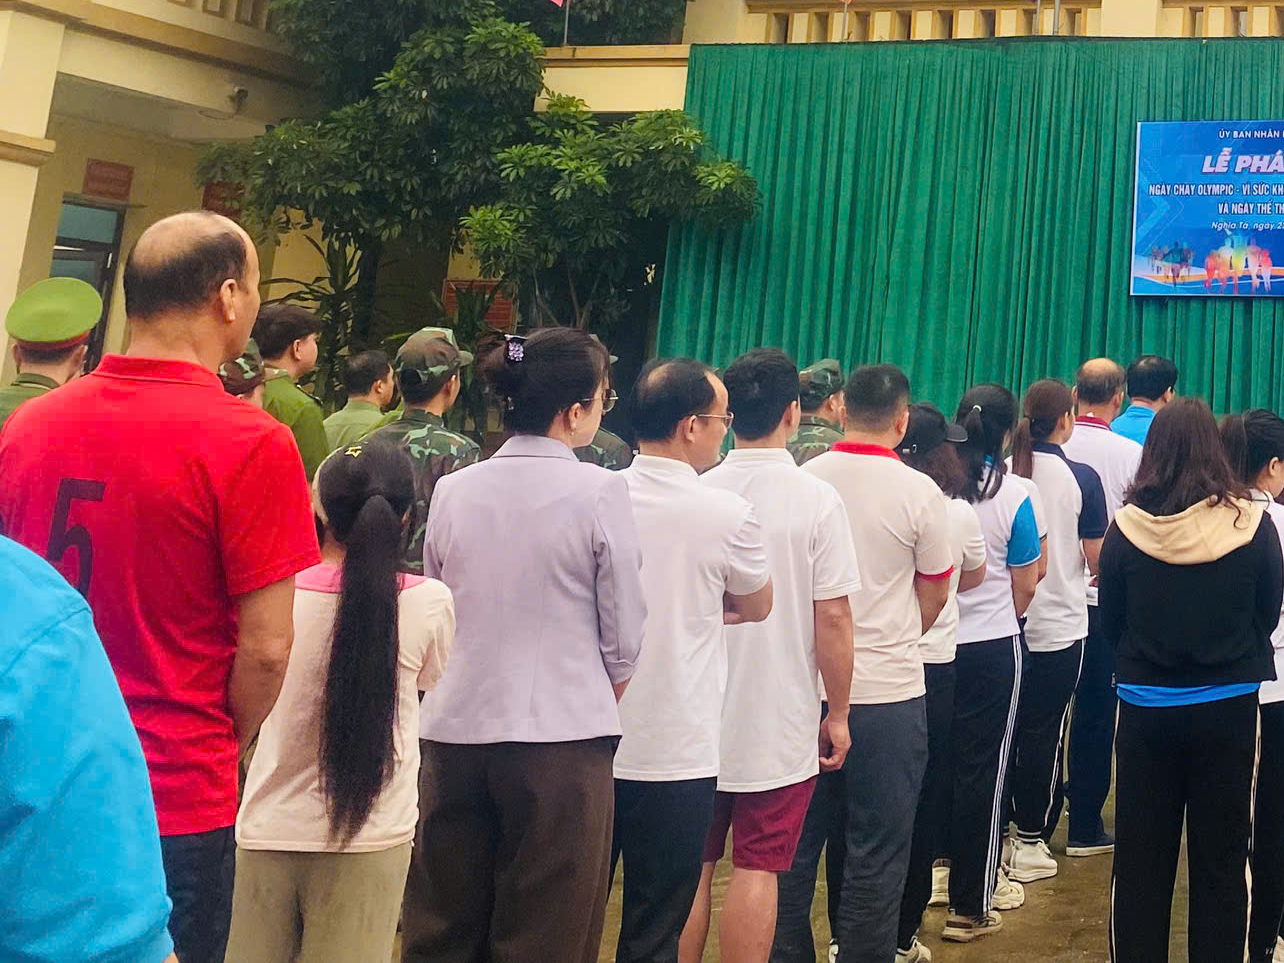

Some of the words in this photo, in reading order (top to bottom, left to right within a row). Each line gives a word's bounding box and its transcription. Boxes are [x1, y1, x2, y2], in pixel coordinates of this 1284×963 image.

[1219, 128, 1231, 138] ỦY
[1233, 130, 1252, 138] BAN
[1254, 128, 1280, 138] NHÂN
[1202, 147, 1233, 173] LỄ
[1149, 183, 1171, 195] NGÀY
[1174, 184, 1195, 197] CHẠY
[1197, 184, 1234, 196] OLYMPIC
[1253, 181, 1270, 195] SỨC
[1218, 200, 1229, 214] VÀ
[1231, 200, 1255, 214] NGÀY
[1257, 198, 1273, 214] THỂ
[46, 477, 107, 598] 5
